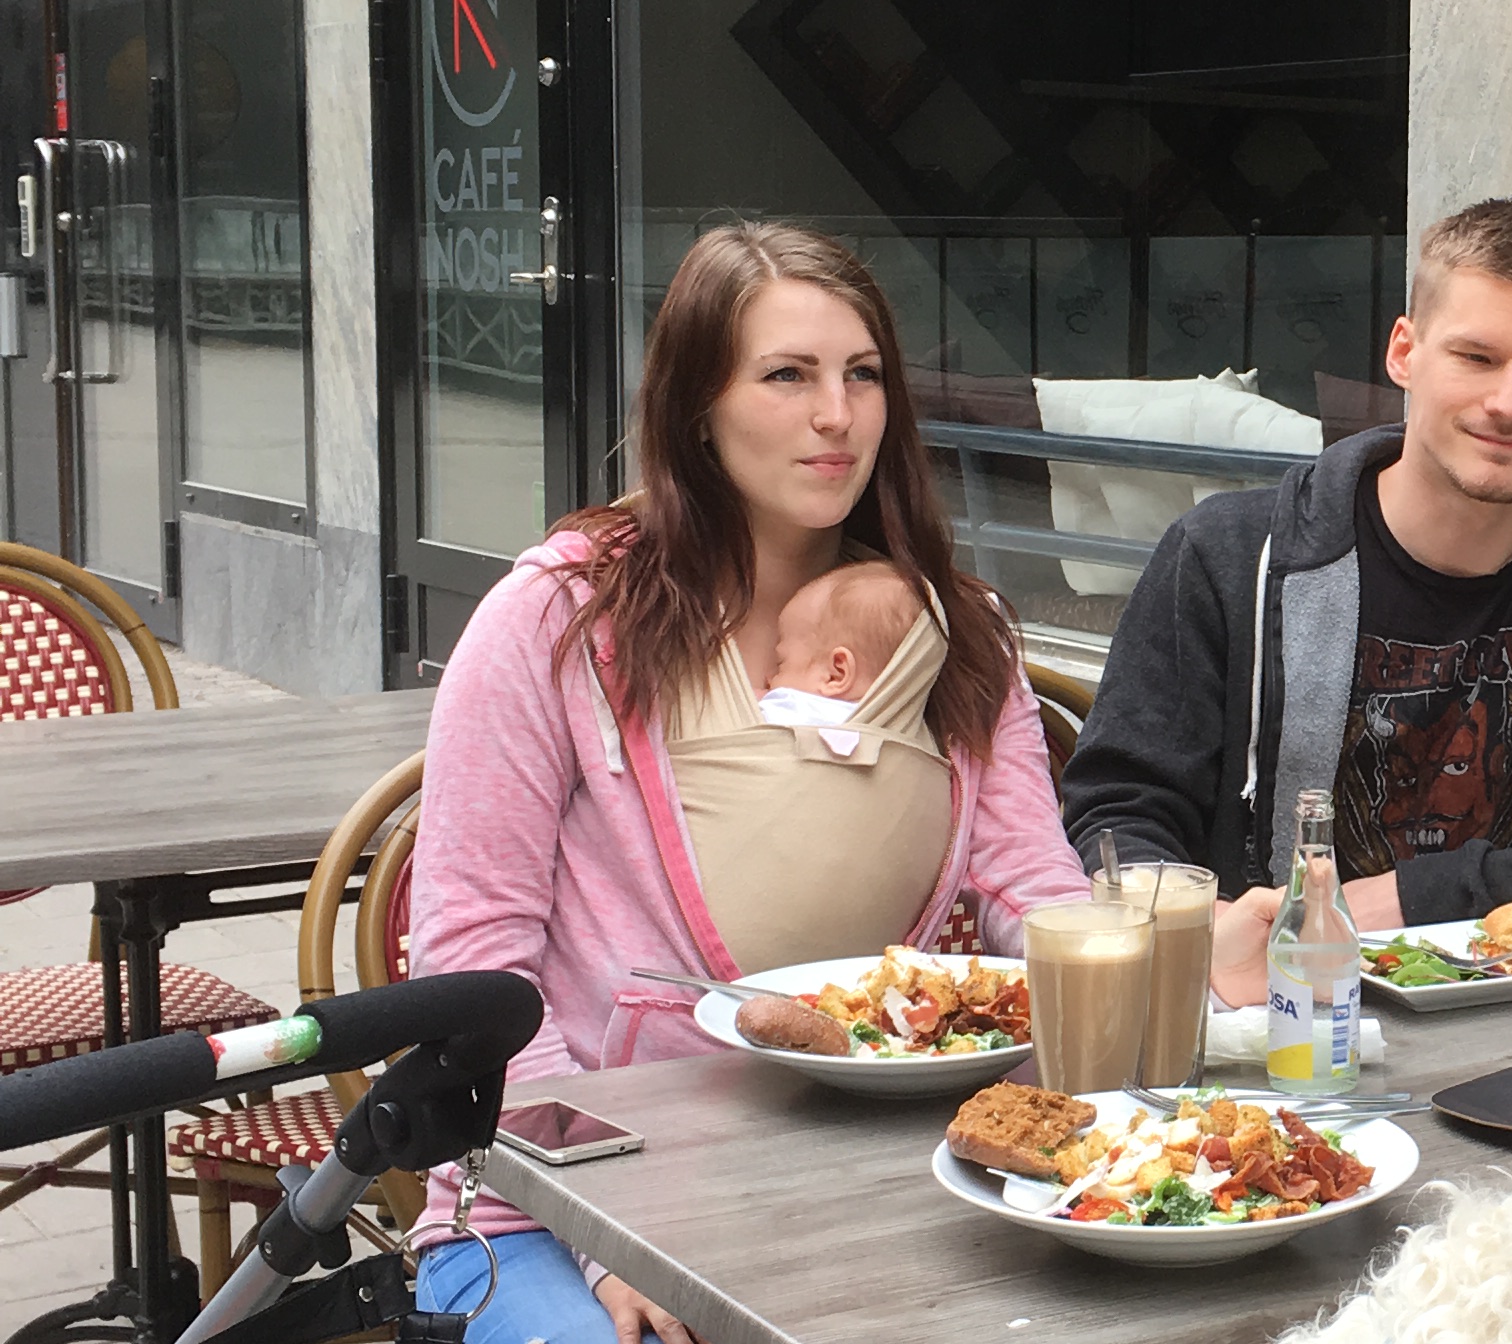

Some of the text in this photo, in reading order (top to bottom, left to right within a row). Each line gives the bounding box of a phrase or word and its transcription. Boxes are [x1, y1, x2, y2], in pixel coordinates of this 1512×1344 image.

[433, 128, 524, 213] CAFÉ
[426, 226, 525, 294] NOSH
[1358, 636, 1467, 690] REET
